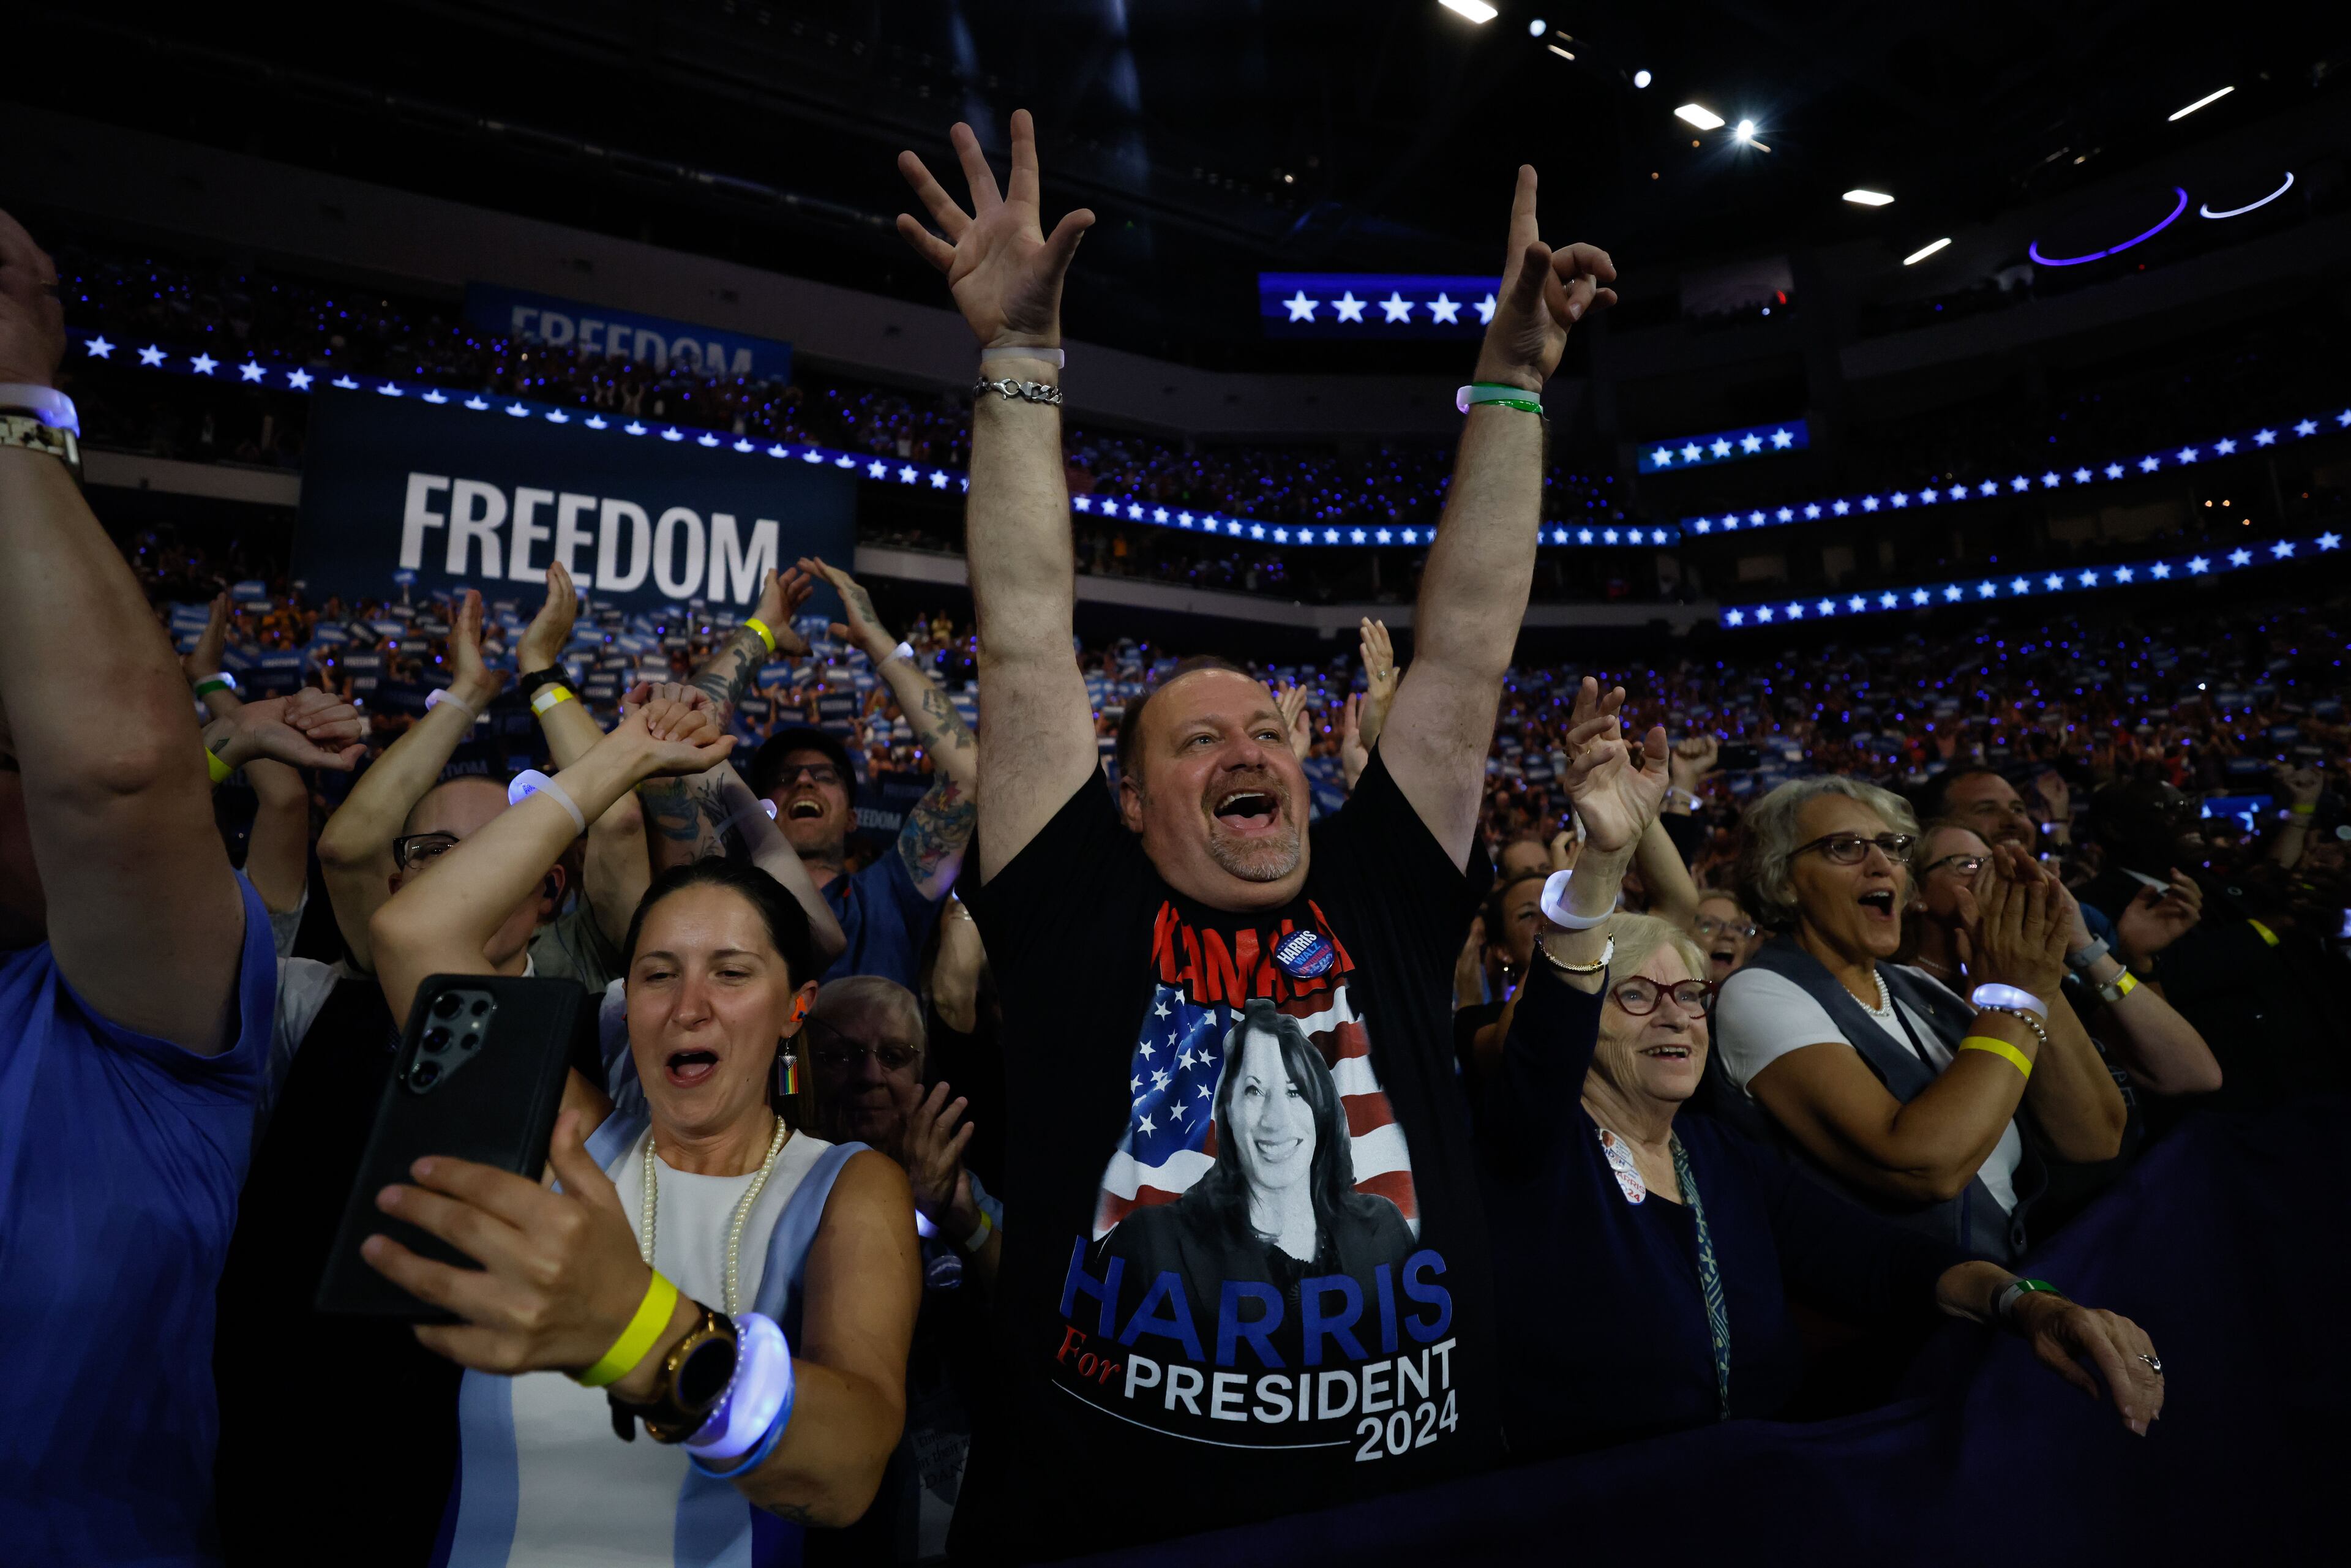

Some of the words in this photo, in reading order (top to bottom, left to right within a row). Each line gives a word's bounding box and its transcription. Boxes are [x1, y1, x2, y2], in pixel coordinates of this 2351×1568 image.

[511, 305, 753, 376] FREEDOM
[399, 471, 780, 606] FREEDOM
[855, 806, 902, 831] EEDOM
[1277, 930, 1318, 965] HARRIS
[1294, 942, 1321, 966] WALZ
[1616, 1171, 1646, 1195] ARRIS
[1059, 1234, 1453, 1369] HARRIS
[1053, 1324, 1122, 1385] For
[1123, 1337, 1457, 1424] PRESIDENT
[1355, 1389, 1459, 1463] 2024
